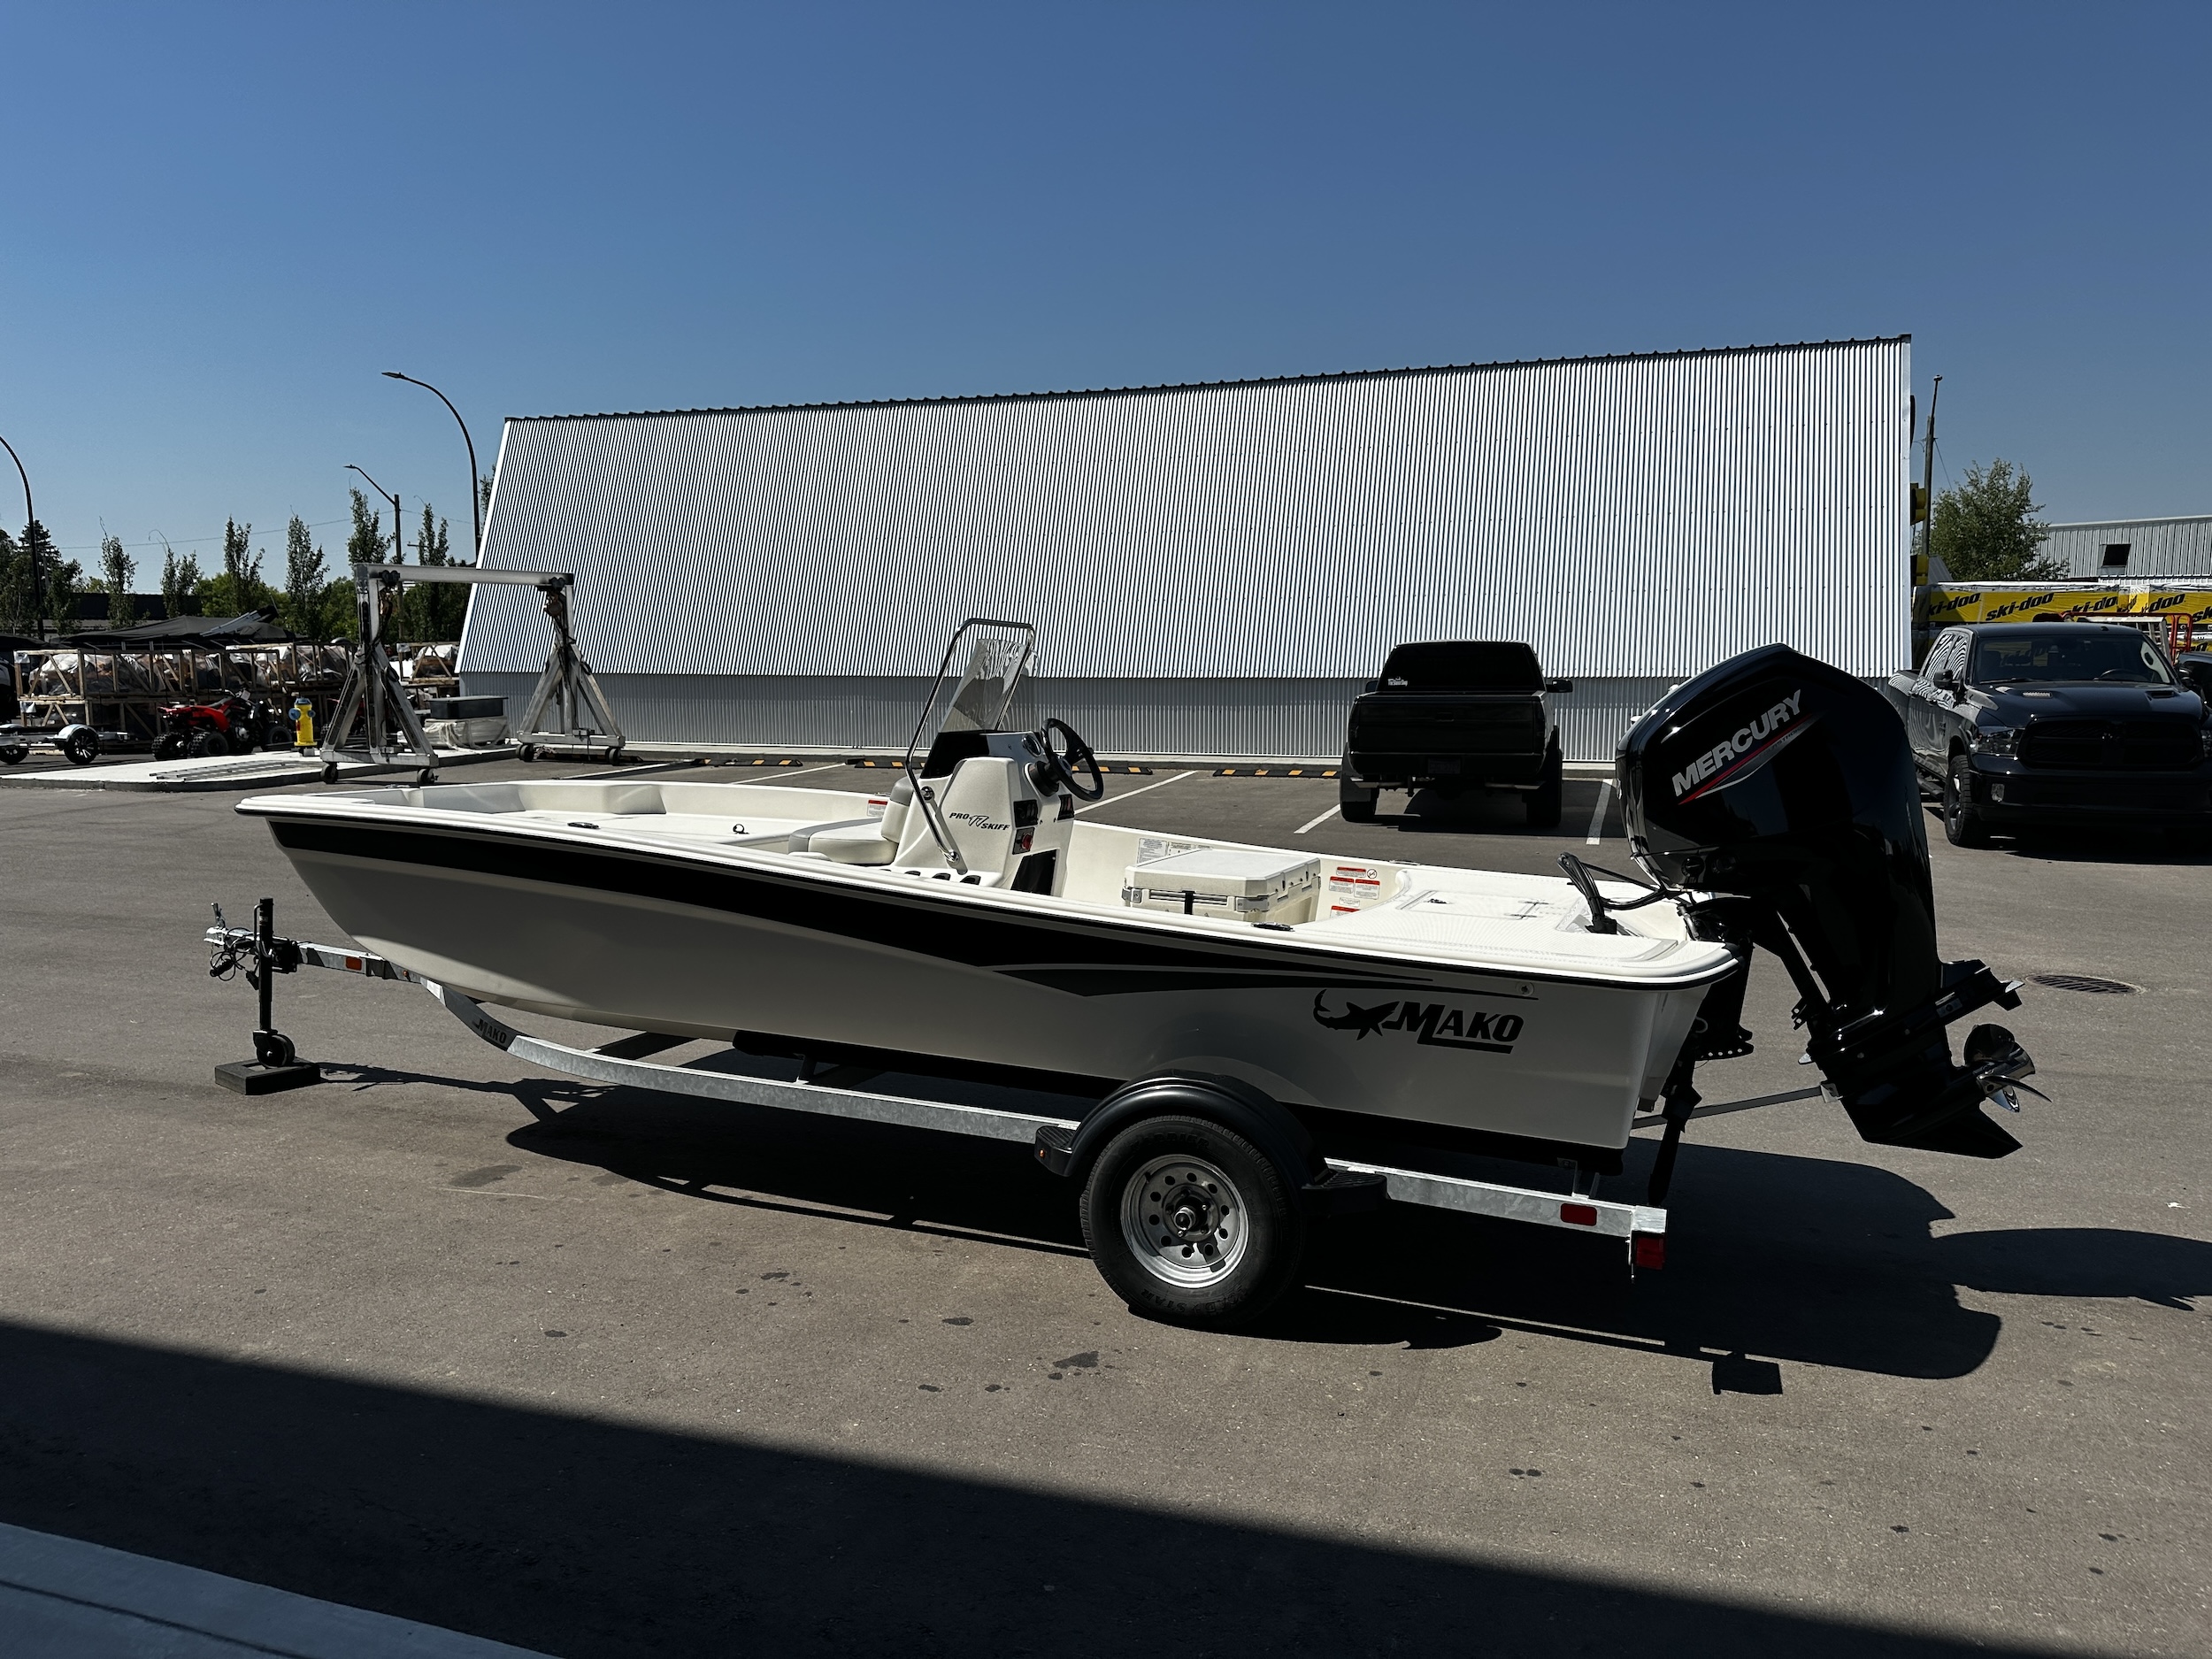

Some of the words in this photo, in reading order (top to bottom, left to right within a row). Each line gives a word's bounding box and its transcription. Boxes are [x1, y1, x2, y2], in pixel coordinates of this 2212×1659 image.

[1927, 592, 1981, 617] ki-doo
[1985, 592, 2055, 621] ski-doo
[2071, 595, 2118, 613] ki-do
[1671, 689, 1801, 797] MERCURY
[968, 815, 989, 826] 17
[472, 1018, 507, 1049] MAKO
[1382, 1001, 1525, 1054] MAKO
